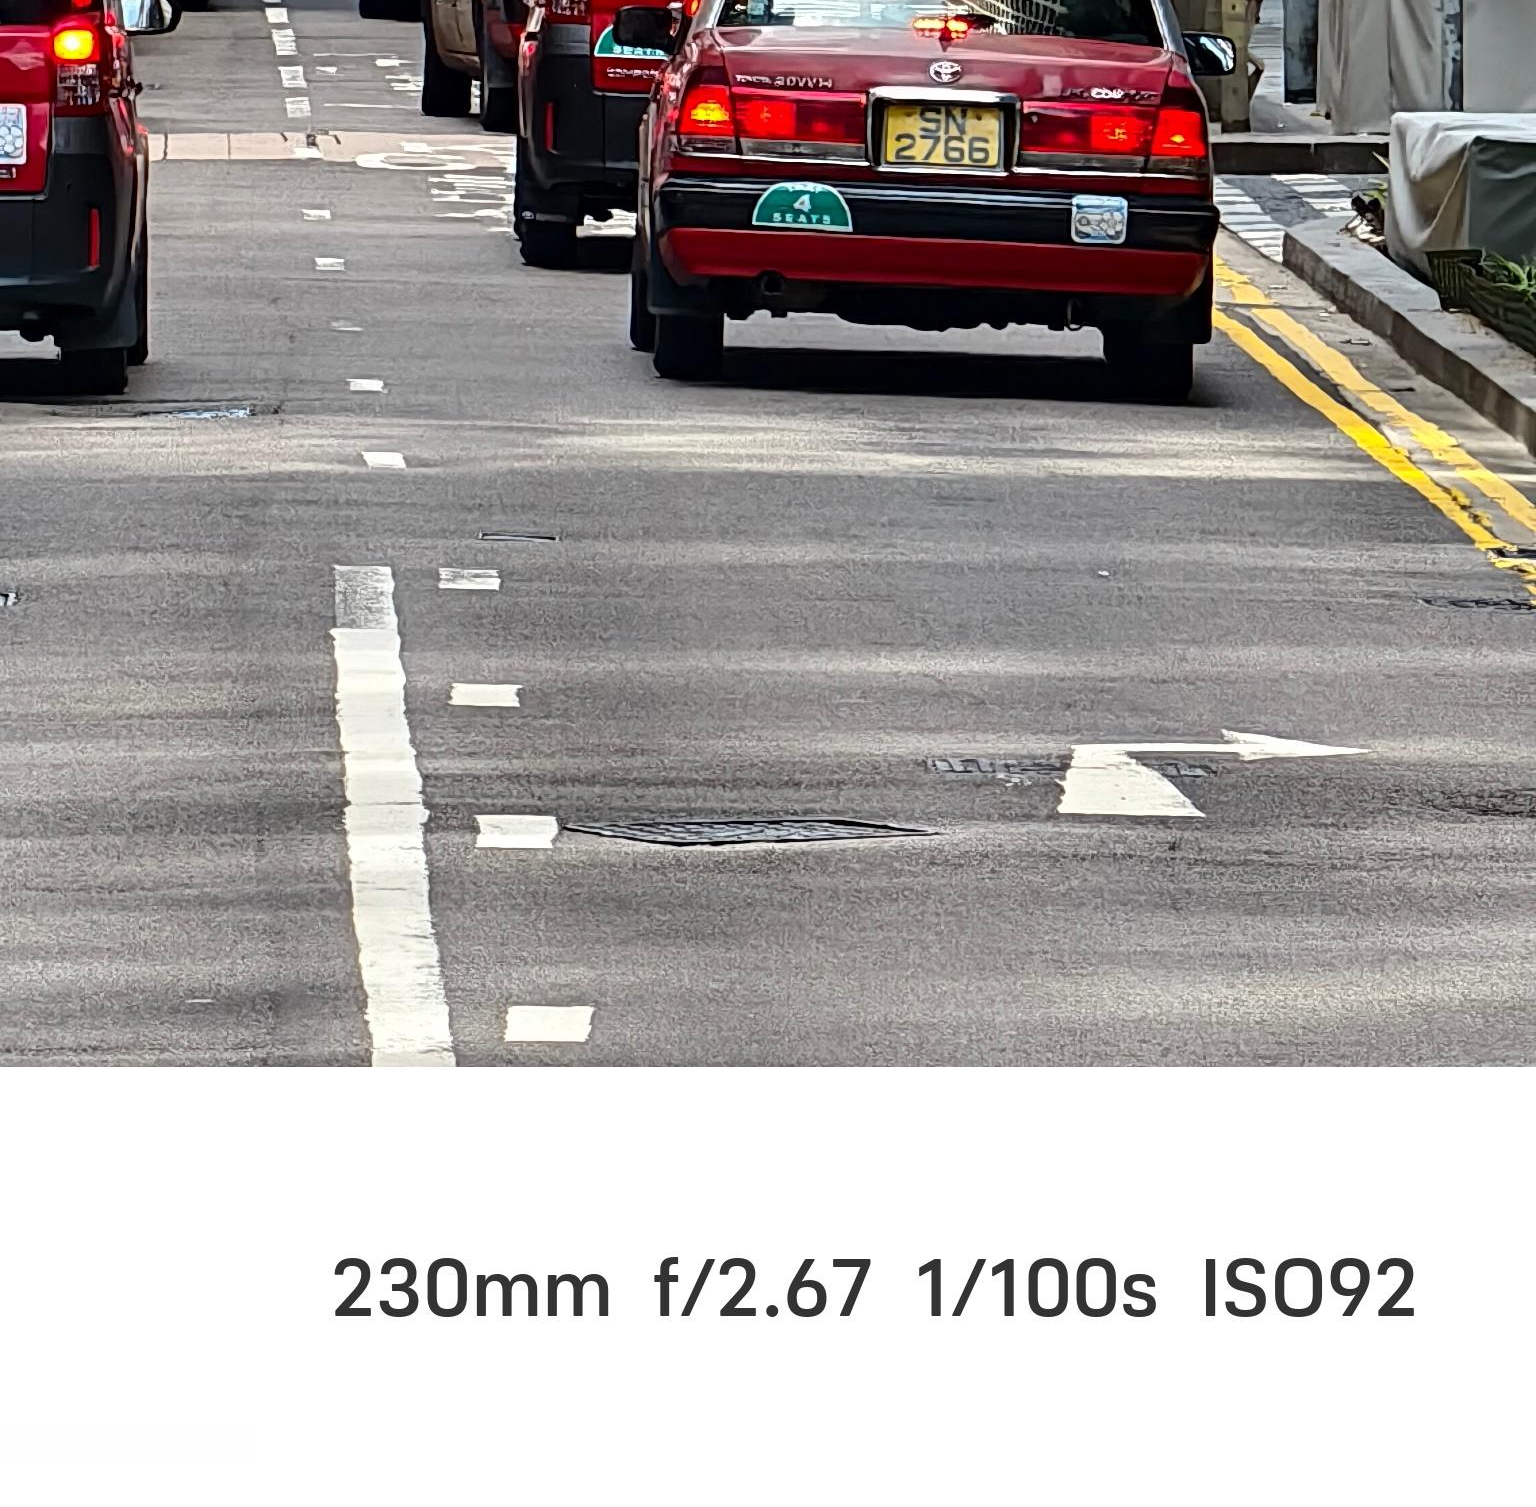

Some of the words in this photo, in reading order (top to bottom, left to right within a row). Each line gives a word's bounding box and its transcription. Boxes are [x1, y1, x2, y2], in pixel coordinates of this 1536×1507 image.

[917, 107, 967, 136] SN
[894, 133, 990, 165] 2766
[792, 194, 812, 212] 4
[771, 212, 832, 226] SEATS
